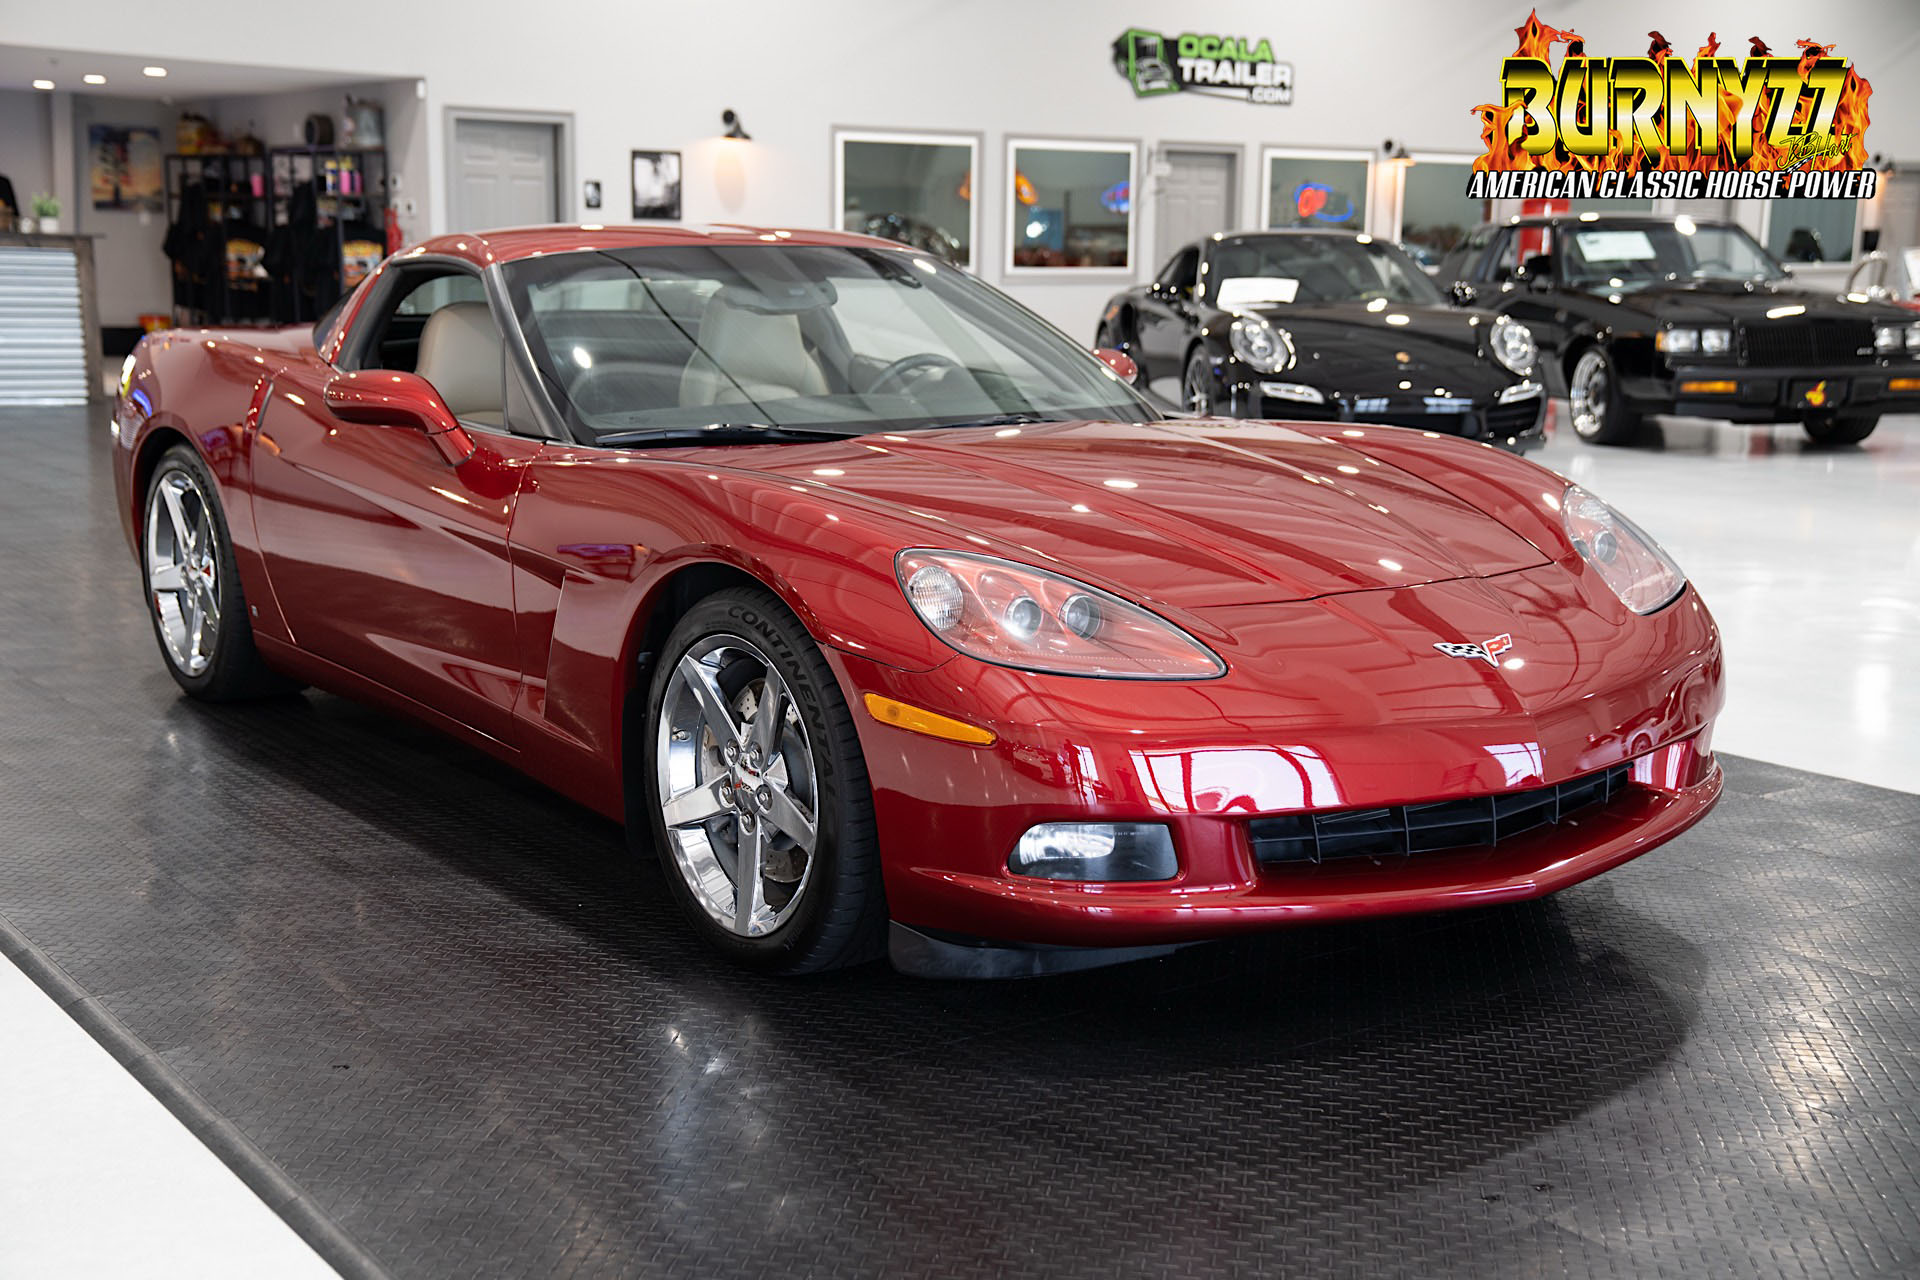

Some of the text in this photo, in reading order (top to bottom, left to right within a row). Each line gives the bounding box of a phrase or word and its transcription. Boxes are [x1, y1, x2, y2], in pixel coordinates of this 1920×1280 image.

[1177, 33, 1274, 62] OCALA
[1177, 56, 1292, 87] TRAILER
[728, 605, 835, 796] CONTINENTAL
